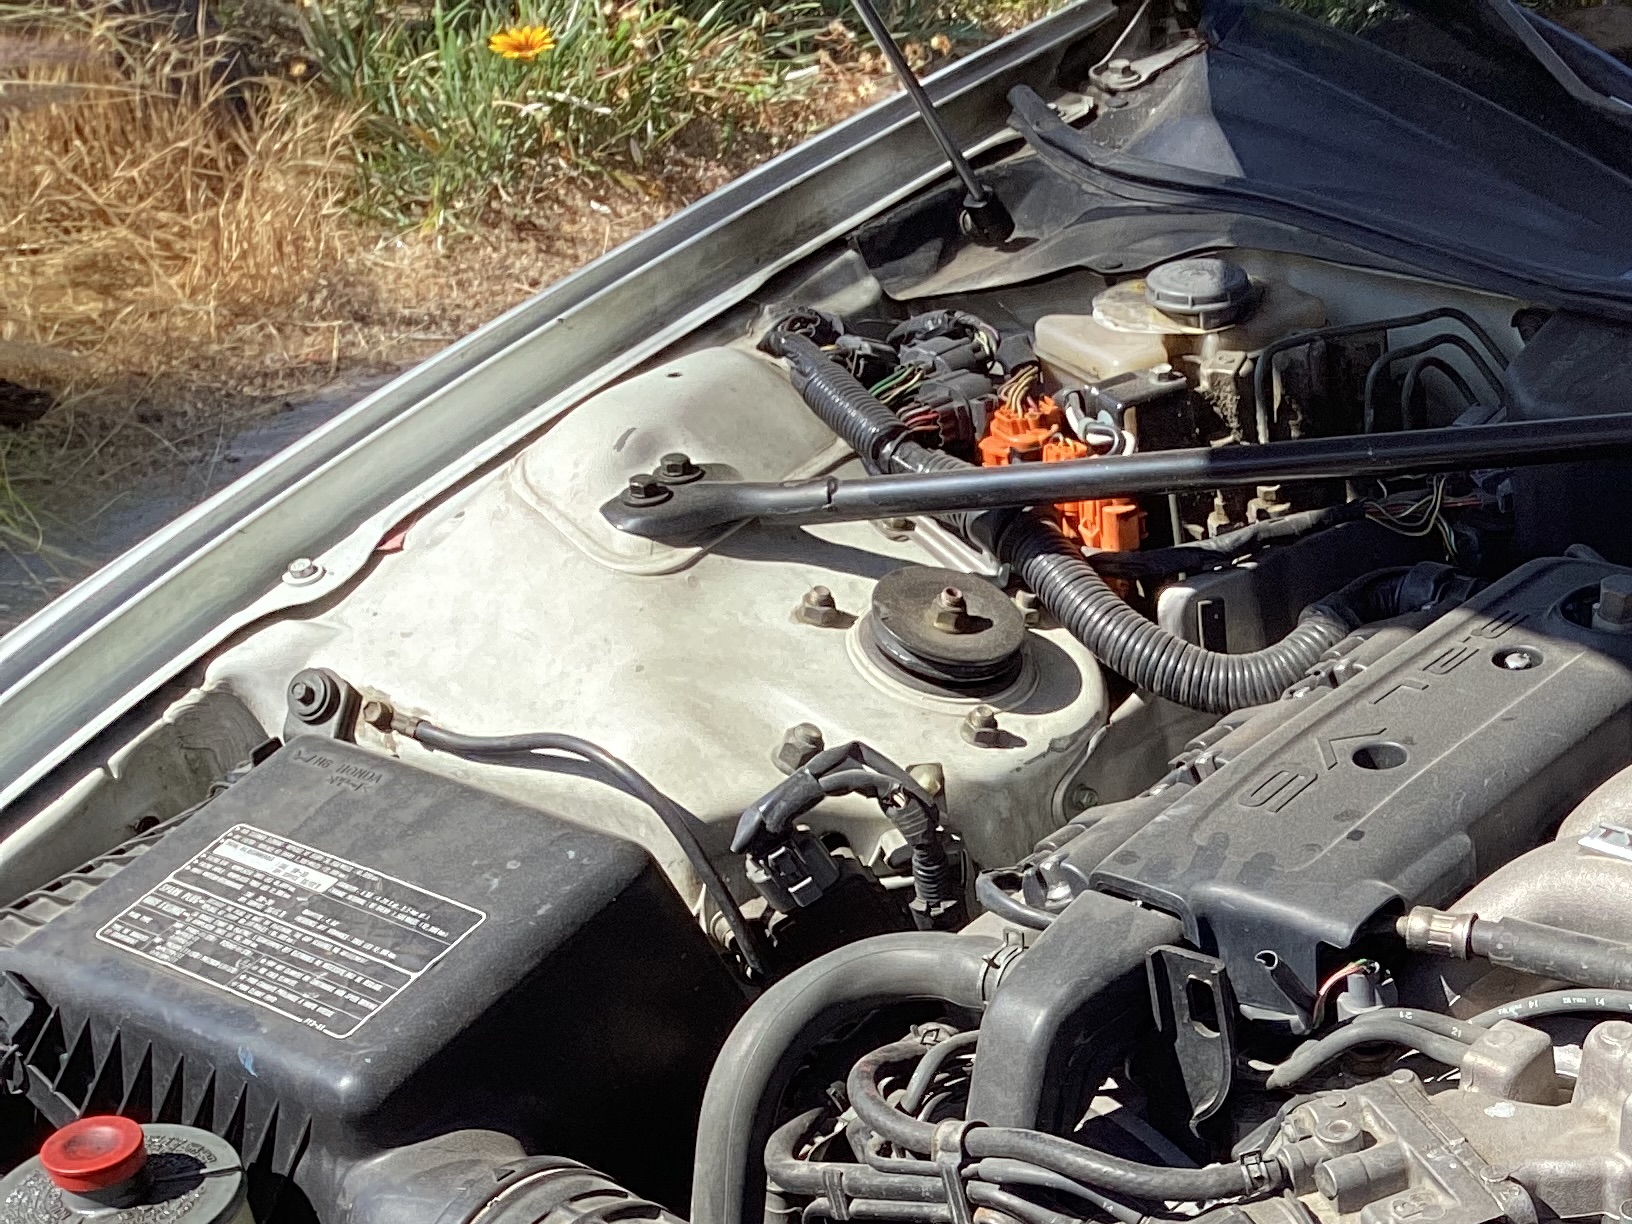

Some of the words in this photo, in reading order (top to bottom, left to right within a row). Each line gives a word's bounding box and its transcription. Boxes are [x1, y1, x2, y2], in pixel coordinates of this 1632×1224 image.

[1239, 727, 1388, 812] V6
[1594, 997, 1605, 1006] 14
[1450, 1026, 1462, 1038] 21
